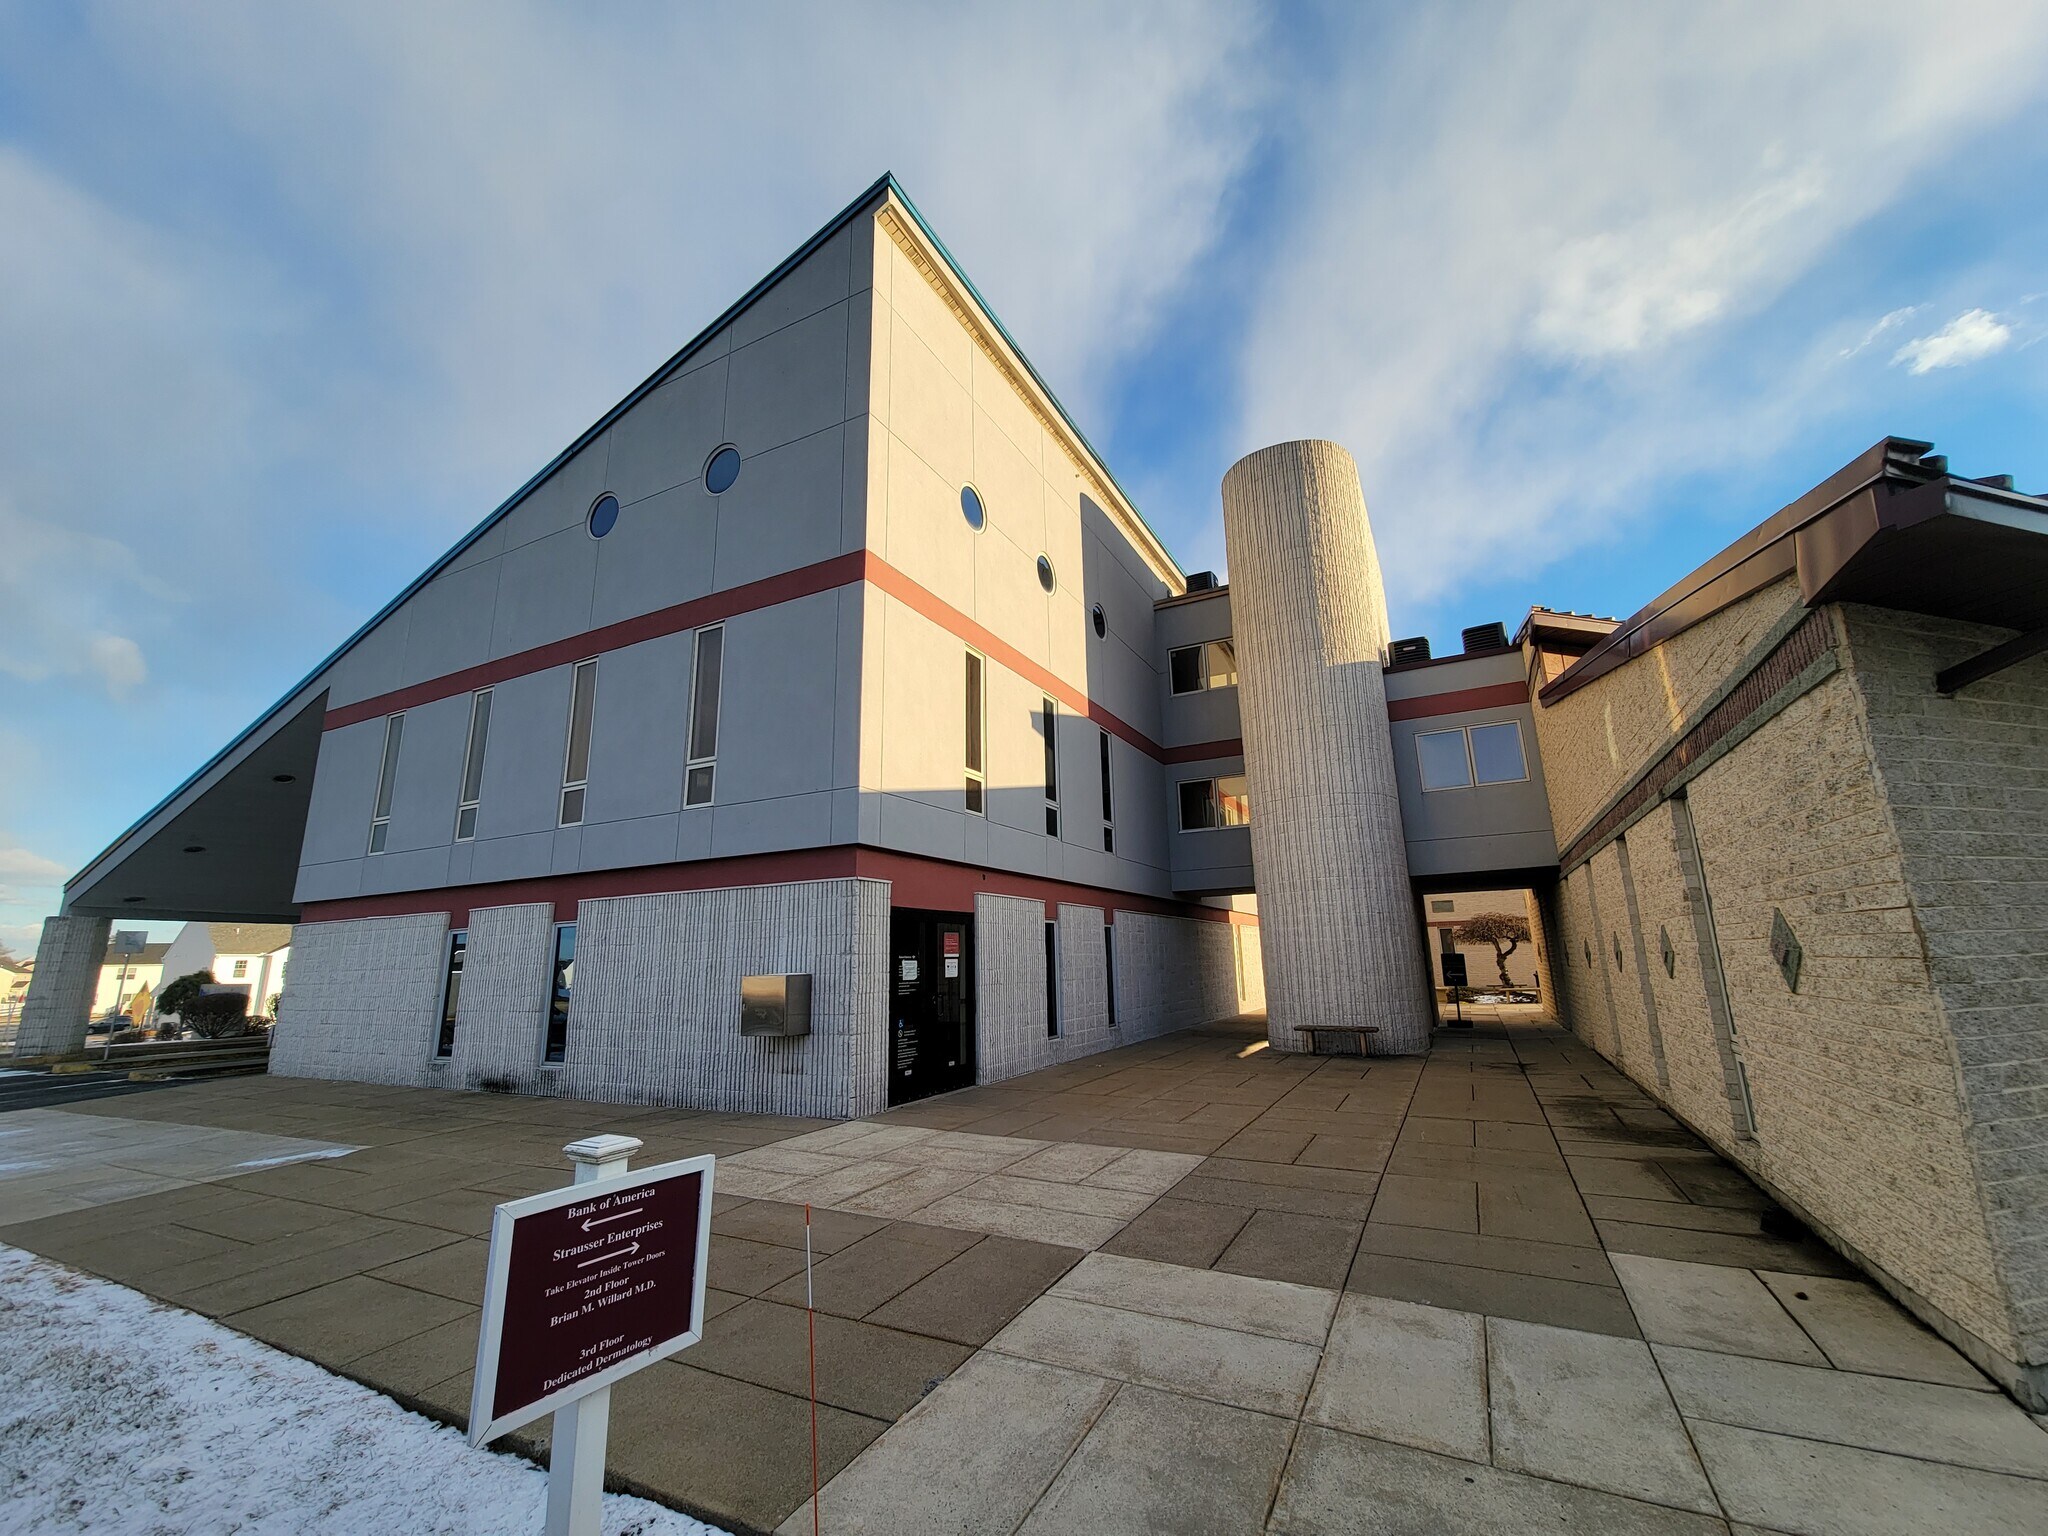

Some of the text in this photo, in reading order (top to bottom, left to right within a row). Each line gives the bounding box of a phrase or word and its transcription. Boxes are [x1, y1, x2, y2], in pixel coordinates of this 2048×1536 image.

[567, 1187, 655, 1219] Bank of America
[553, 1219, 662, 1261] Strausser Enterprises
[545, 1249, 665, 1296] Take Elevator Inside Tower Doors
[584, 1276, 629, 1298] 2nd Floor
[550, 1281, 655, 1327] Brian M. Willard M.D.
[543, 1335, 652, 1390] Dedicated Dermatology
[579, 1333, 624, 1359] 3rd Floor
